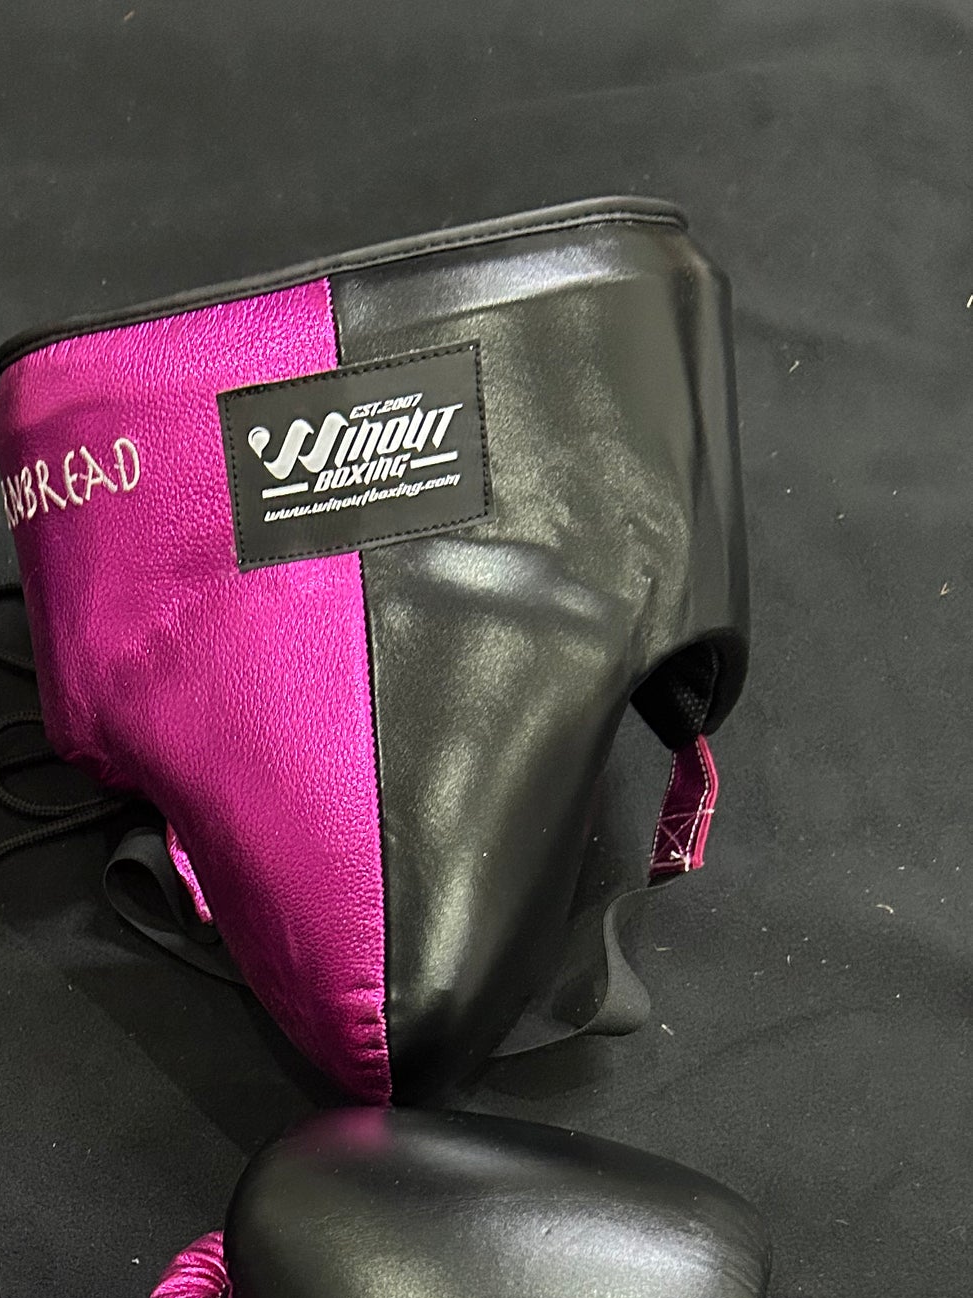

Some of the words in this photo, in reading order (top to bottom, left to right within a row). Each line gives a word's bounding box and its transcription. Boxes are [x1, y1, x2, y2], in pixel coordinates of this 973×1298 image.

[349, 392, 423, 420] EST.2007
[313, 452, 411, 493] BOXING
[263, 472, 461, 522] www.winoutboxing.com
